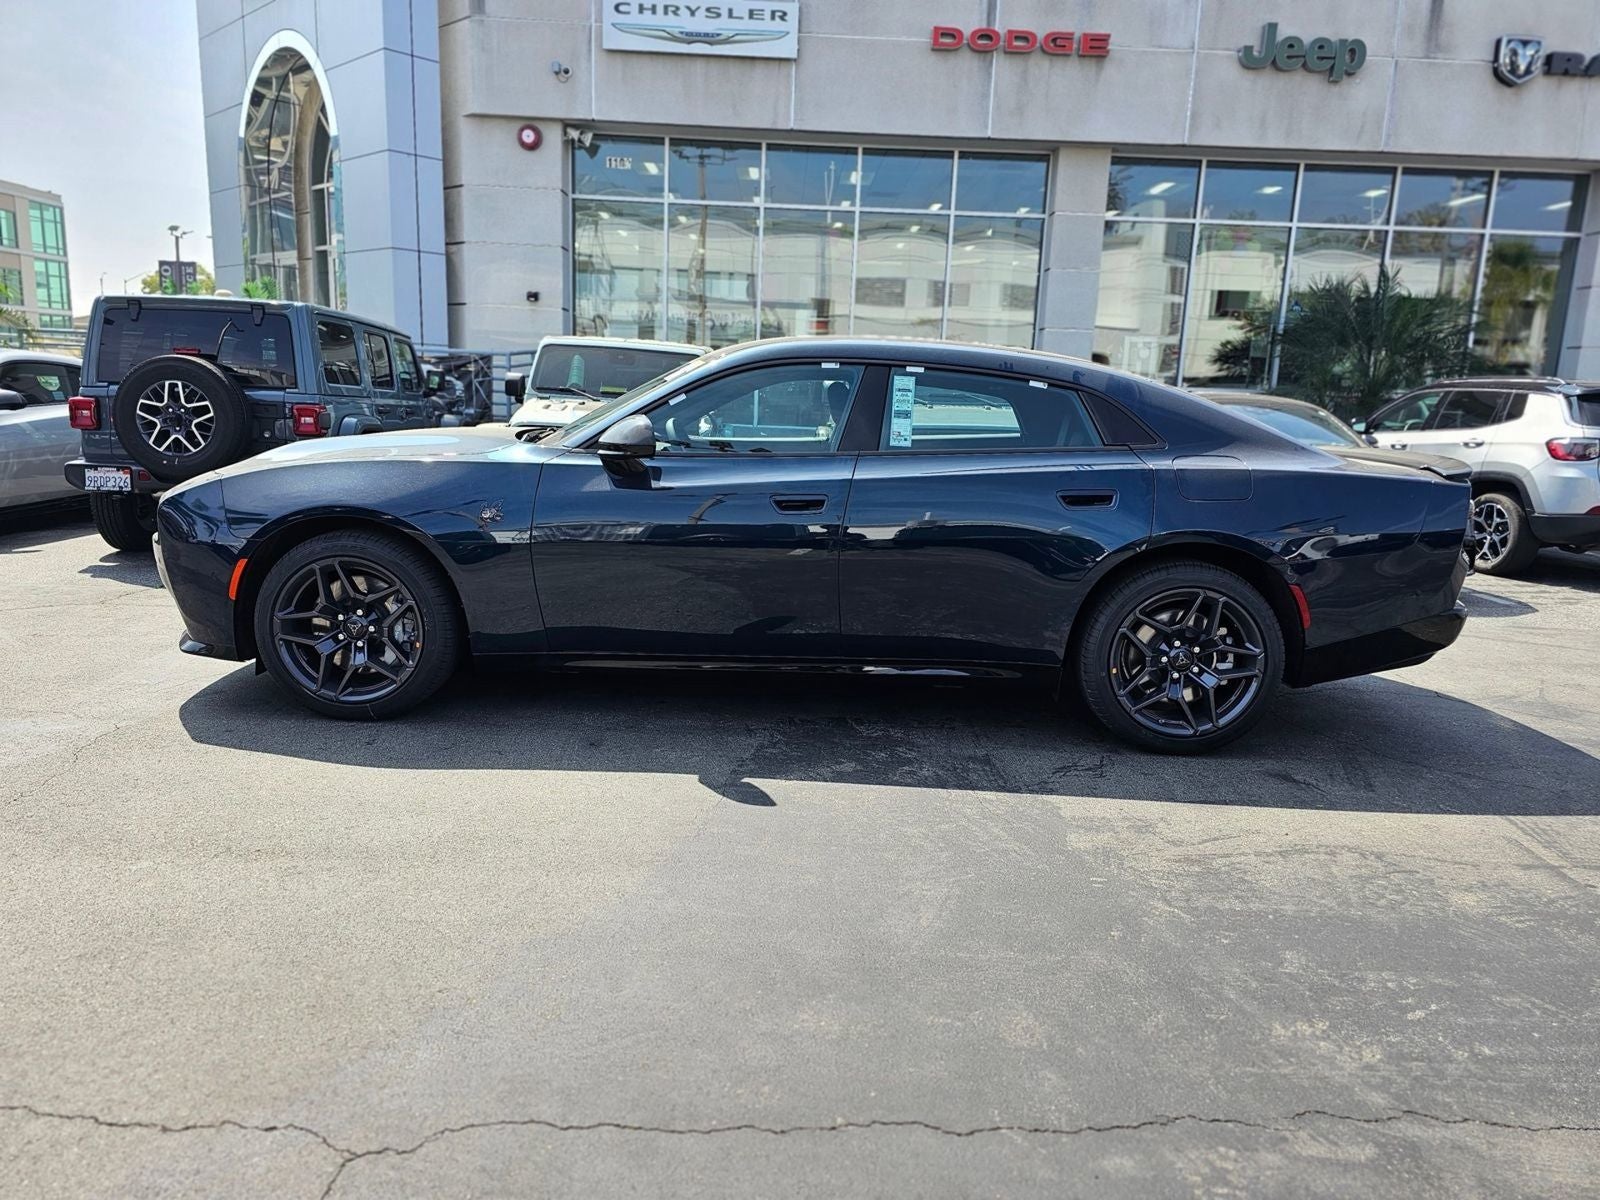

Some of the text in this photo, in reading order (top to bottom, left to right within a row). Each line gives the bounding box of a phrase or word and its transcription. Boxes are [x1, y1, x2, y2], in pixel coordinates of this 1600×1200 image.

[614, 2, 788, 22] CHRYSLER
[931, 26, 1111, 57] DODGE
[1238, 22, 1367, 83] Jeep
[87, 475, 129, 488] 9RDP326
